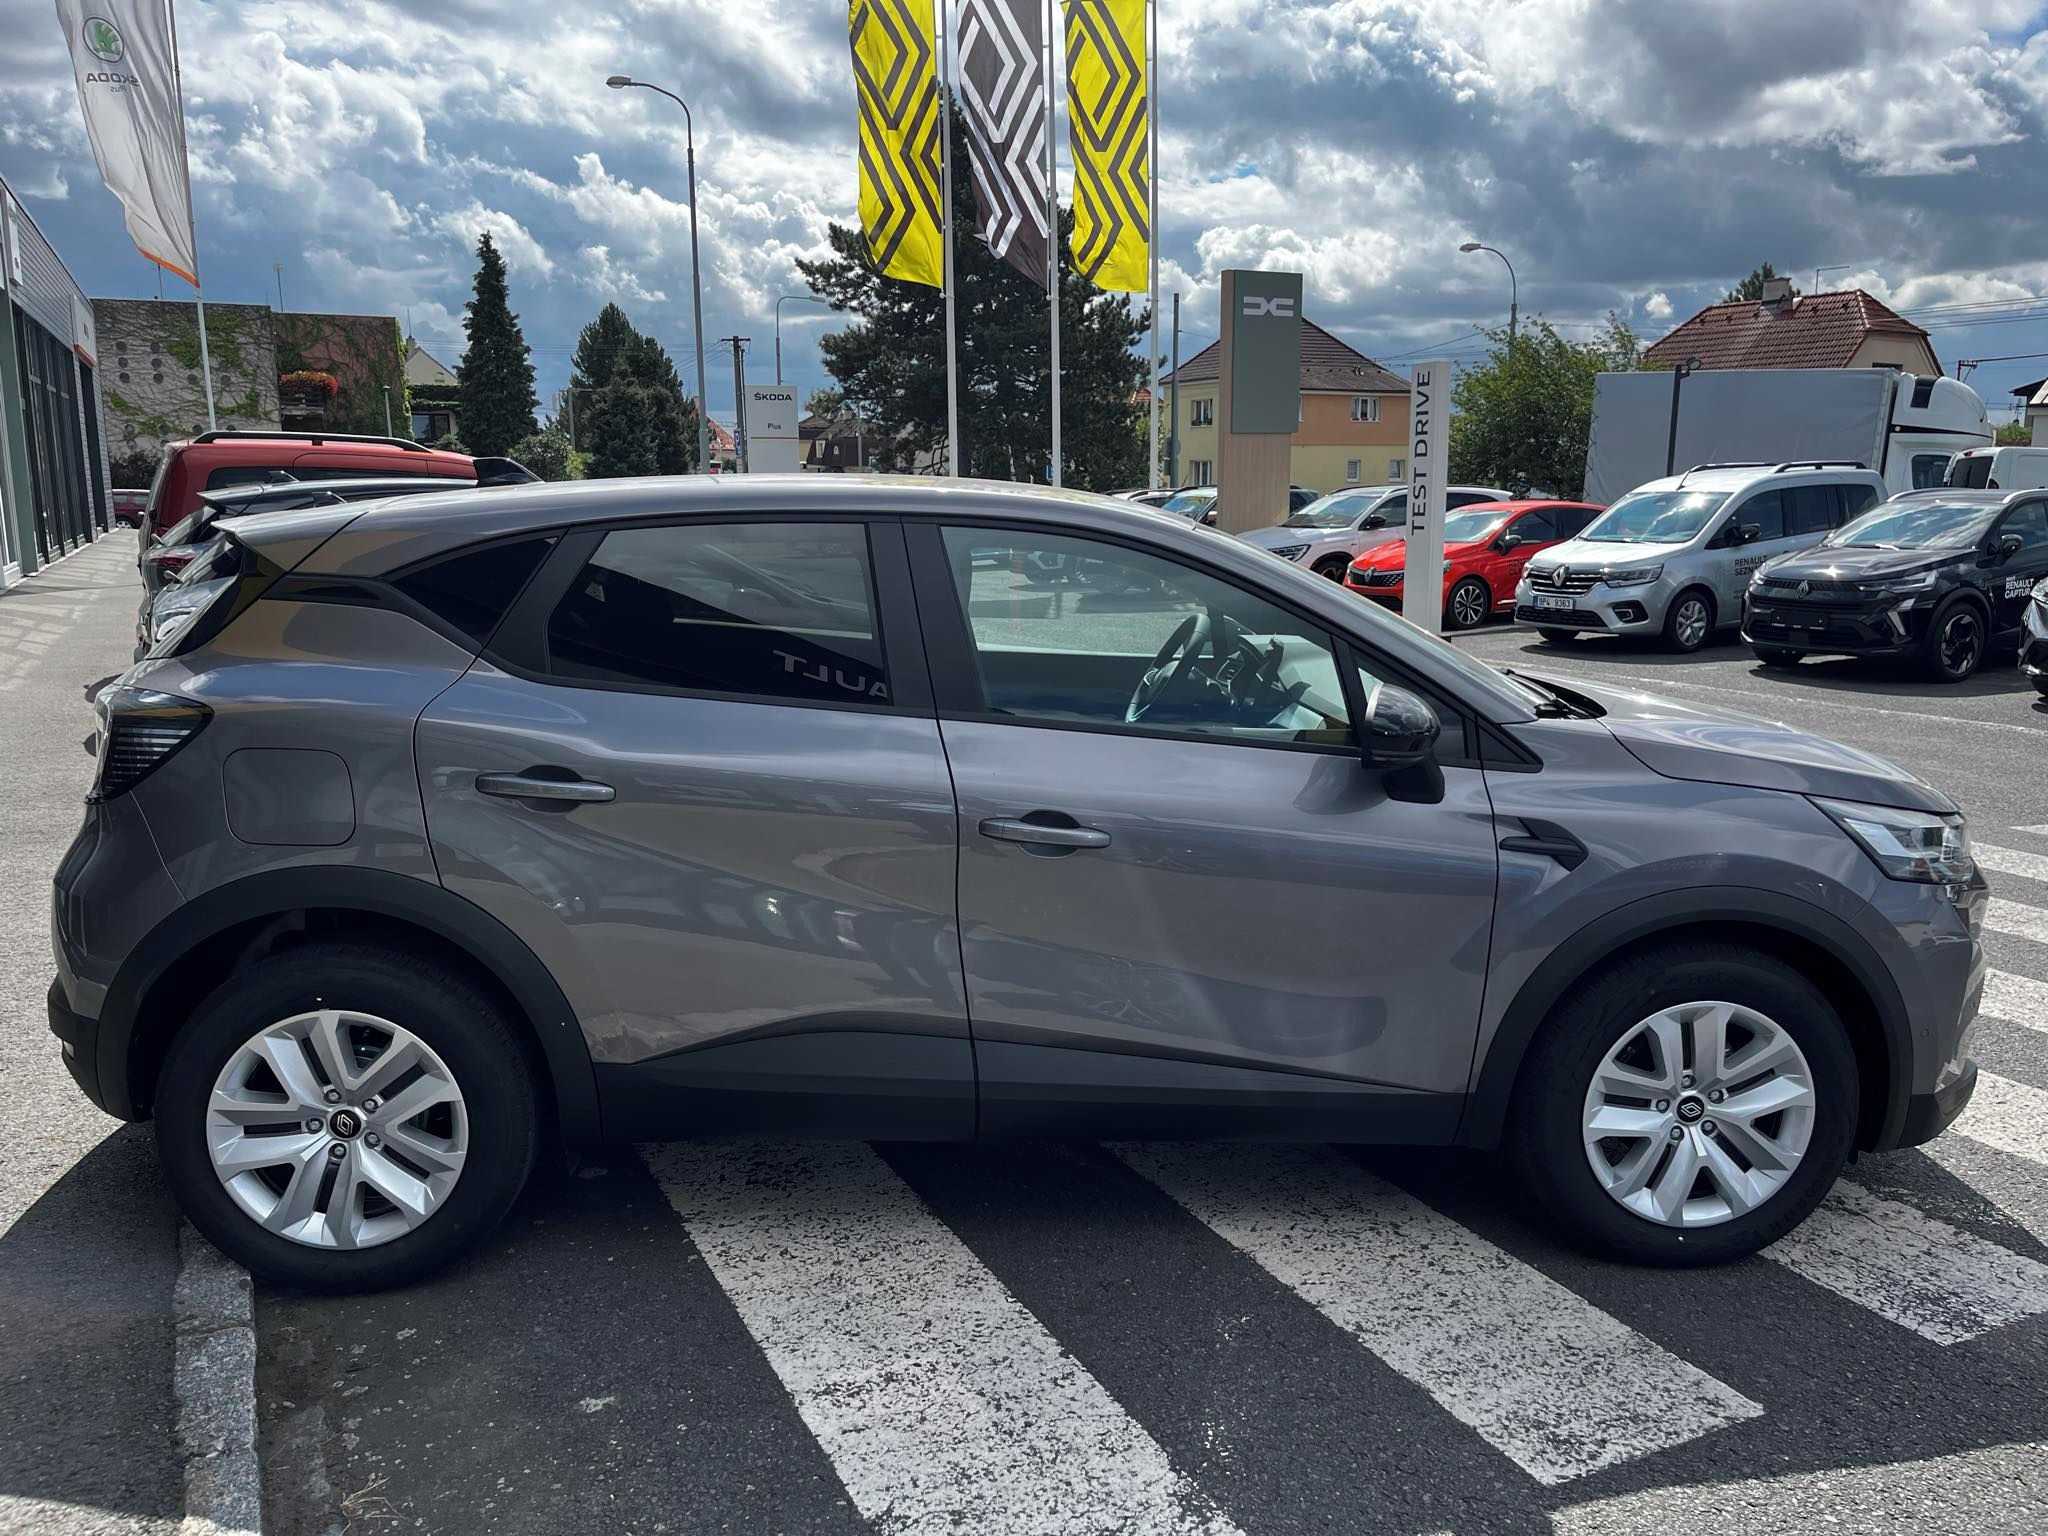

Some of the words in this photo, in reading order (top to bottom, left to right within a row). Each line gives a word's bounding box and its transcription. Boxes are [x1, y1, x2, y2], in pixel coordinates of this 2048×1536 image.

[754, 392, 793, 401] ŠKODA
[1414, 370, 1431, 459] DRIVE
[1411, 466, 1427, 536] TEST
[1735, 555, 1767, 567] RENAULT
[2005, 578, 2034, 590] RENAULT
[2004, 587, 2031, 599] CAPTUR
